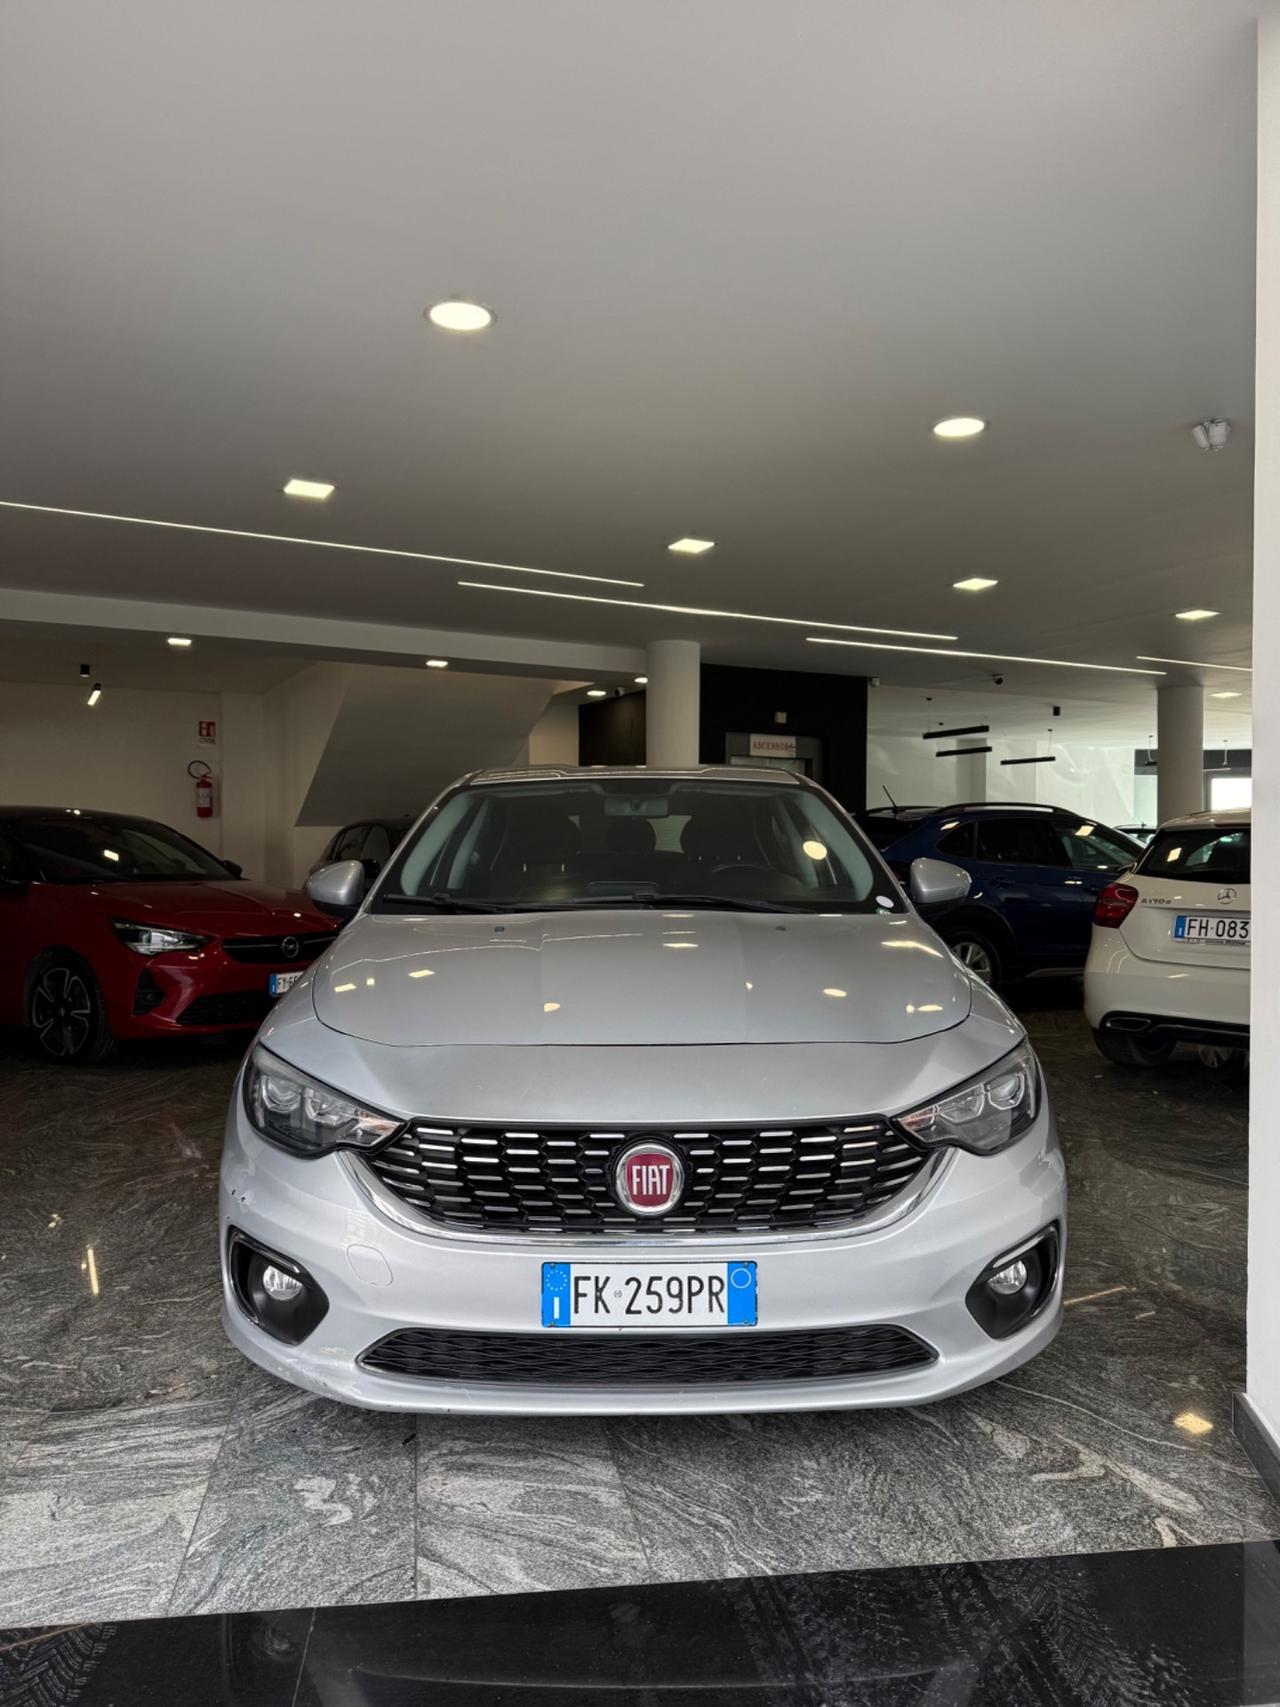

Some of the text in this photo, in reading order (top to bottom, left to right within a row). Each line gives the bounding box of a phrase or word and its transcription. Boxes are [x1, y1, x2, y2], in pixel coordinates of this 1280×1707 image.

[1187, 919, 1209, 937] FH
[1215, 920, 1250, 939] 083
[632, 1165, 670, 1196] FIAT
[573, 1275, 611, 1314] FK
[624, 1275, 726, 1315] 259PR
